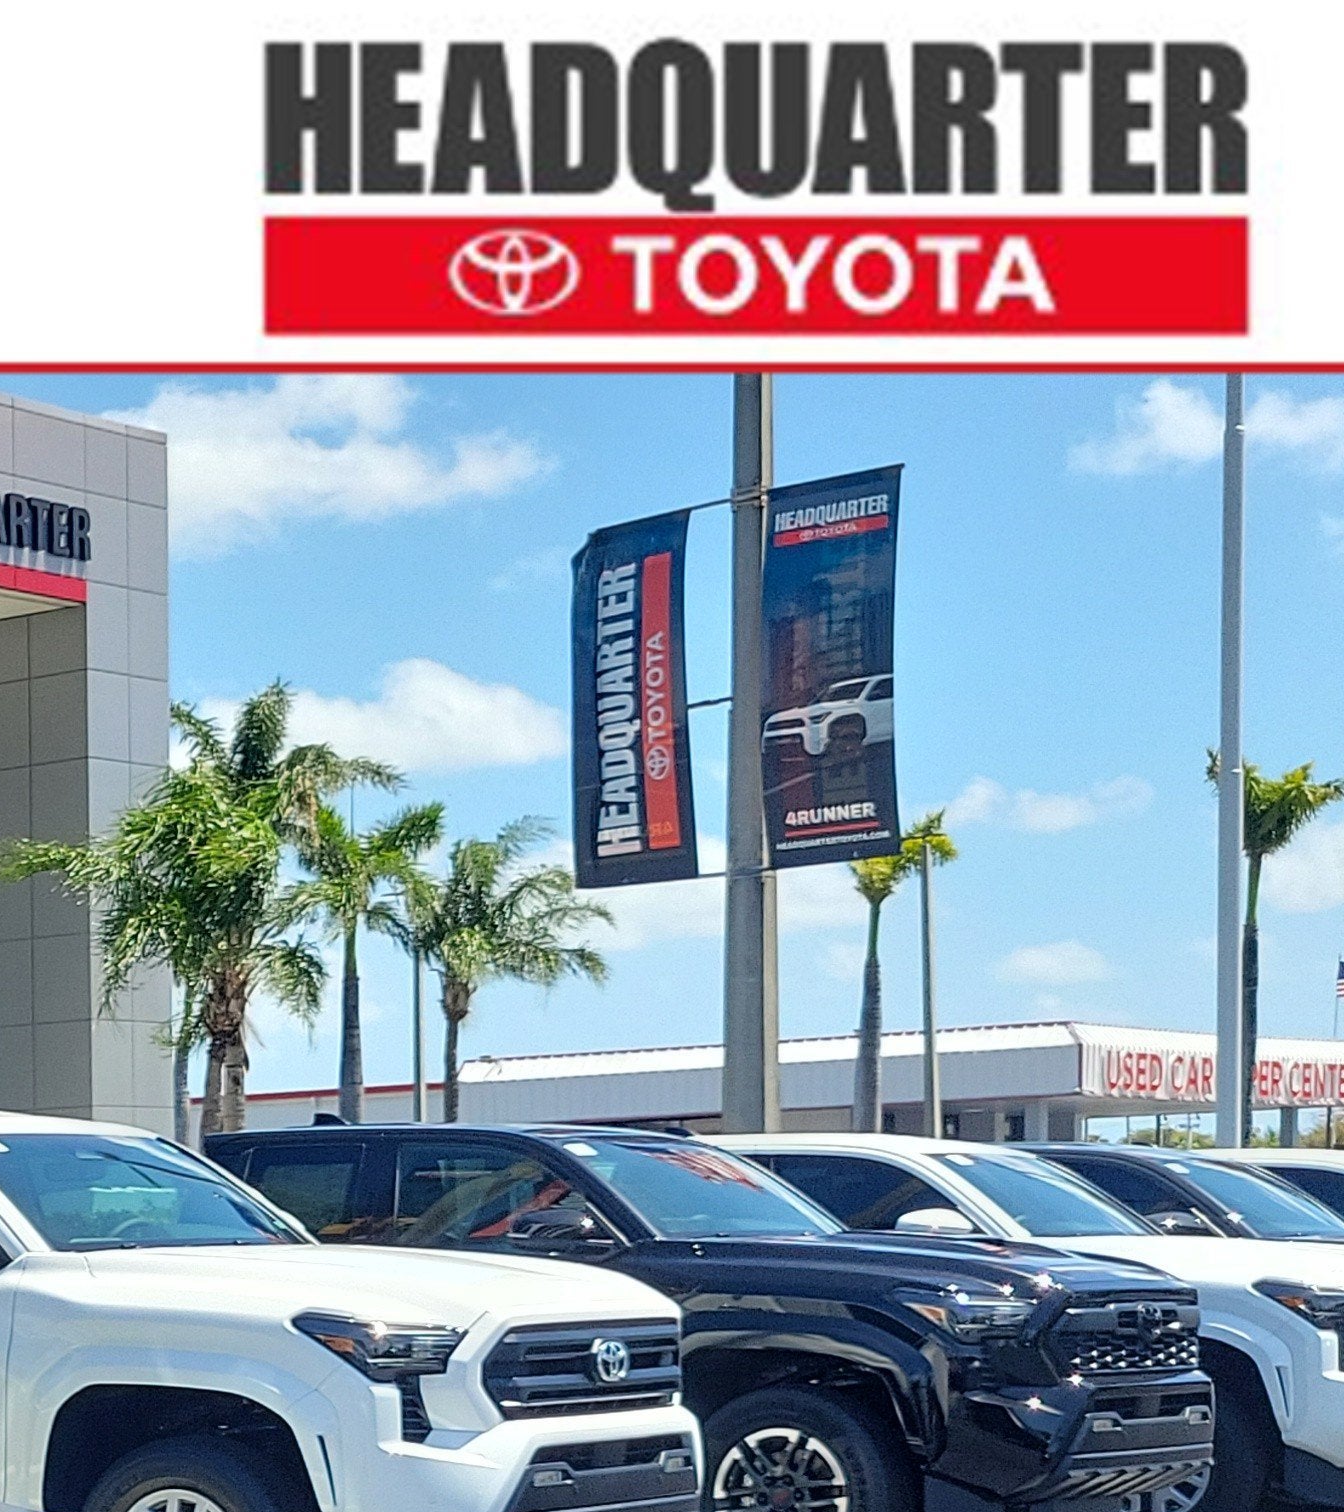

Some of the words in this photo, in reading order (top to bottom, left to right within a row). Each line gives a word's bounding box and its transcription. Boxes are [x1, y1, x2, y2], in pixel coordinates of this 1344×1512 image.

[774, 494, 889, 533] HEADQUARTER
[813, 522, 858, 539] TOYOTA
[646, 630, 667, 744] TOYOTA
[596, 562, 643, 858] HEADQUARTER
[785, 801, 877, 827] 4RUNNER
[1106, 1050, 1163, 1092] USED
[1170, 1055, 1214, 1096] CAR
